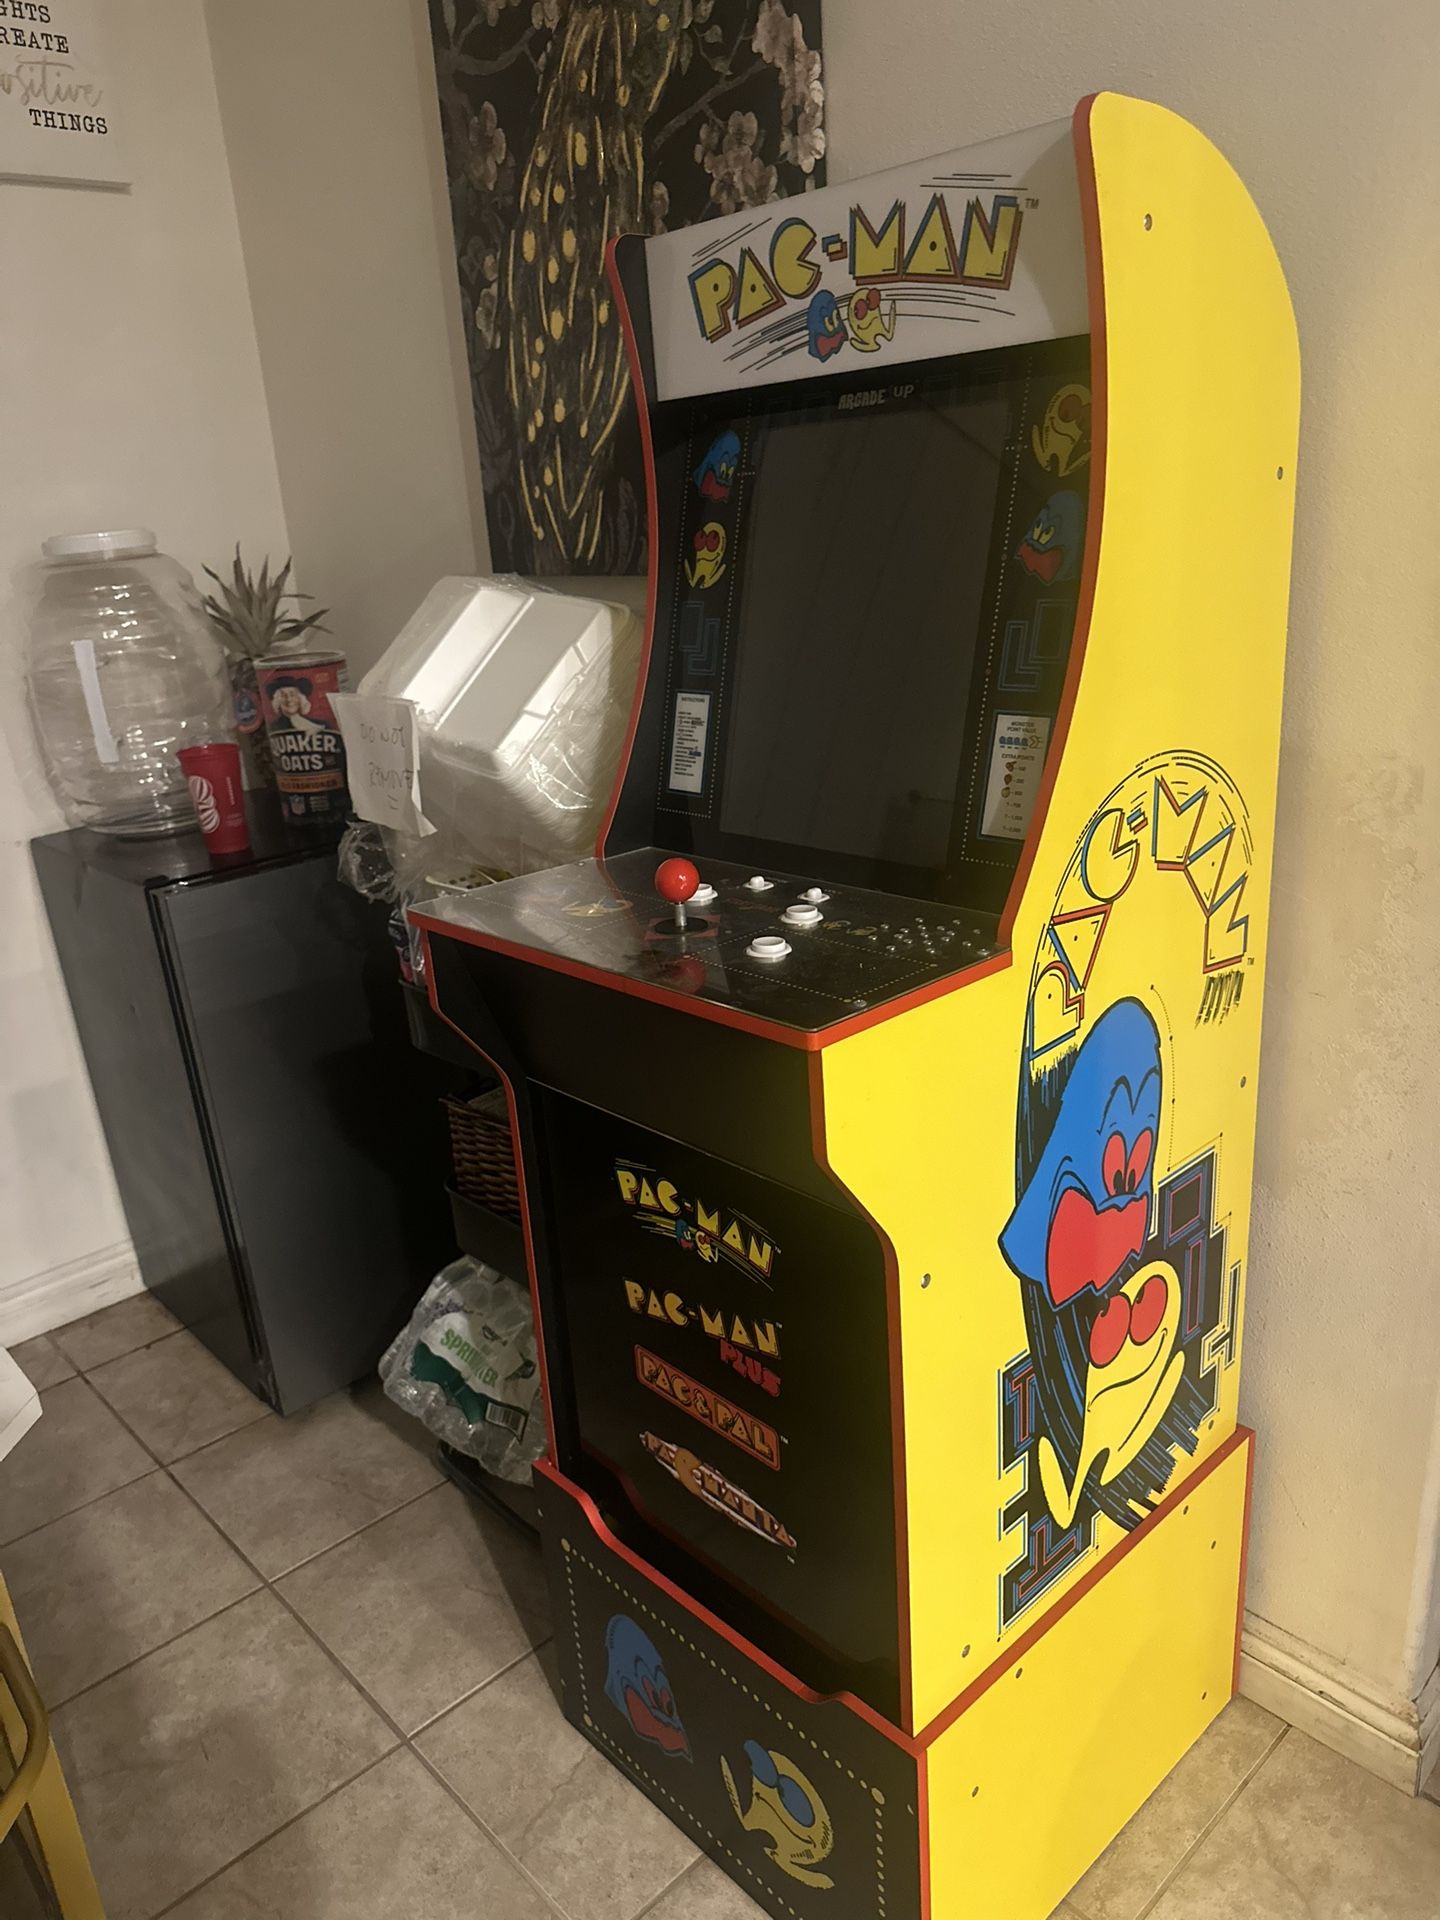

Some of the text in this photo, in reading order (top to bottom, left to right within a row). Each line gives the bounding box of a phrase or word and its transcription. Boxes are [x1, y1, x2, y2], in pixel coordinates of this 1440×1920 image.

[0, 27, 69, 53] REATE
[29, 108, 108, 134] THINGS
[688, 193, 1023, 343] PAC-MAN
[838, 389, 886, 410] ARCADE
[270, 734, 337, 757] QUAKER
[380, 726, 406, 748] NOT
[281, 754, 323, 772] OATS
[1028, 775, 1249, 1060] PAC-MAN
[615, 1166, 774, 1279] PAC-MAN
[622, 1277, 781, 1360] PAC-MAN
[720, 1337, 781, 1398] PLUS
[640, 1354, 692, 1408] PAC
[692, 1388, 711, 1419] &
[713, 1397, 774, 1461] PAL
